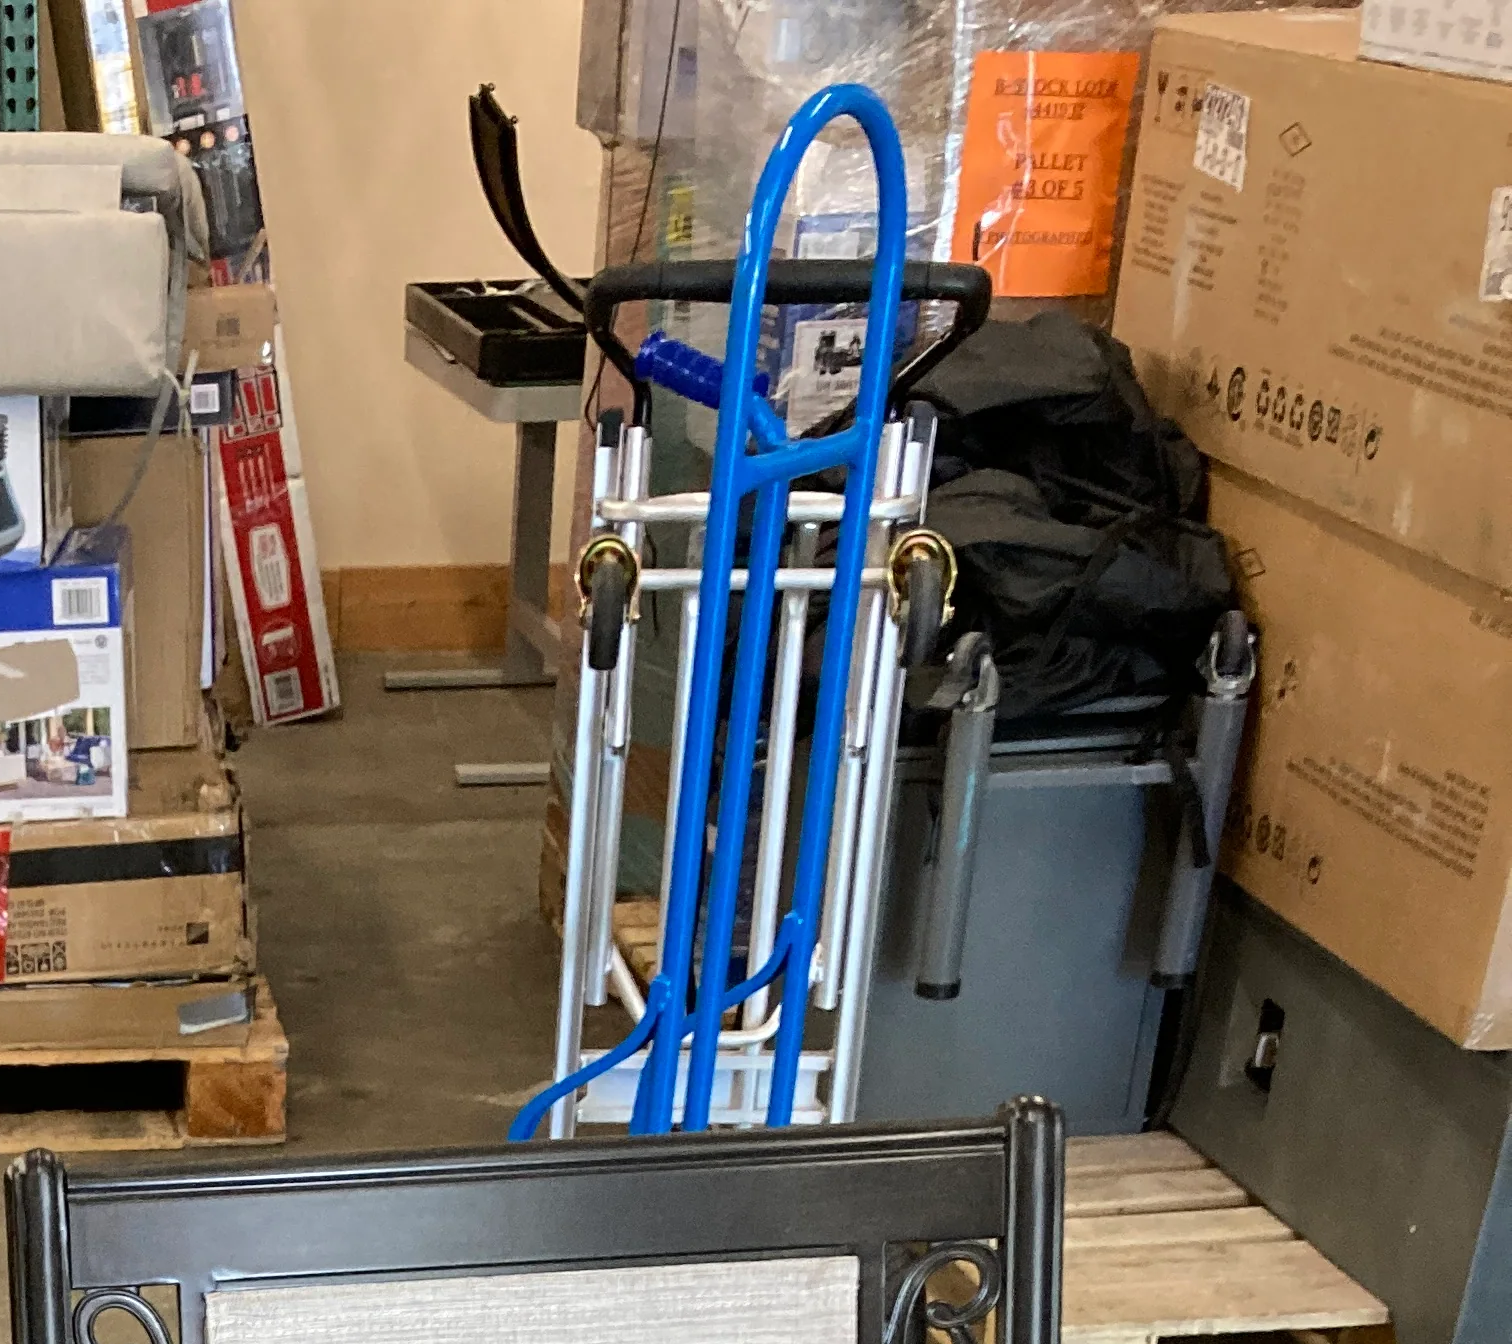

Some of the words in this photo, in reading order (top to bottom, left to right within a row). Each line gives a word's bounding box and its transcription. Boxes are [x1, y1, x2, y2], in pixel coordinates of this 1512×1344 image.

[994, 77, 1071, 97] B-SOCK
[1014, 152, 1089, 171] PALLET
[1041, 179, 1070, 198] OF
[1074, 179, 1085, 199] 5
[985, 230, 1094, 246] PHTOGRAPHED
